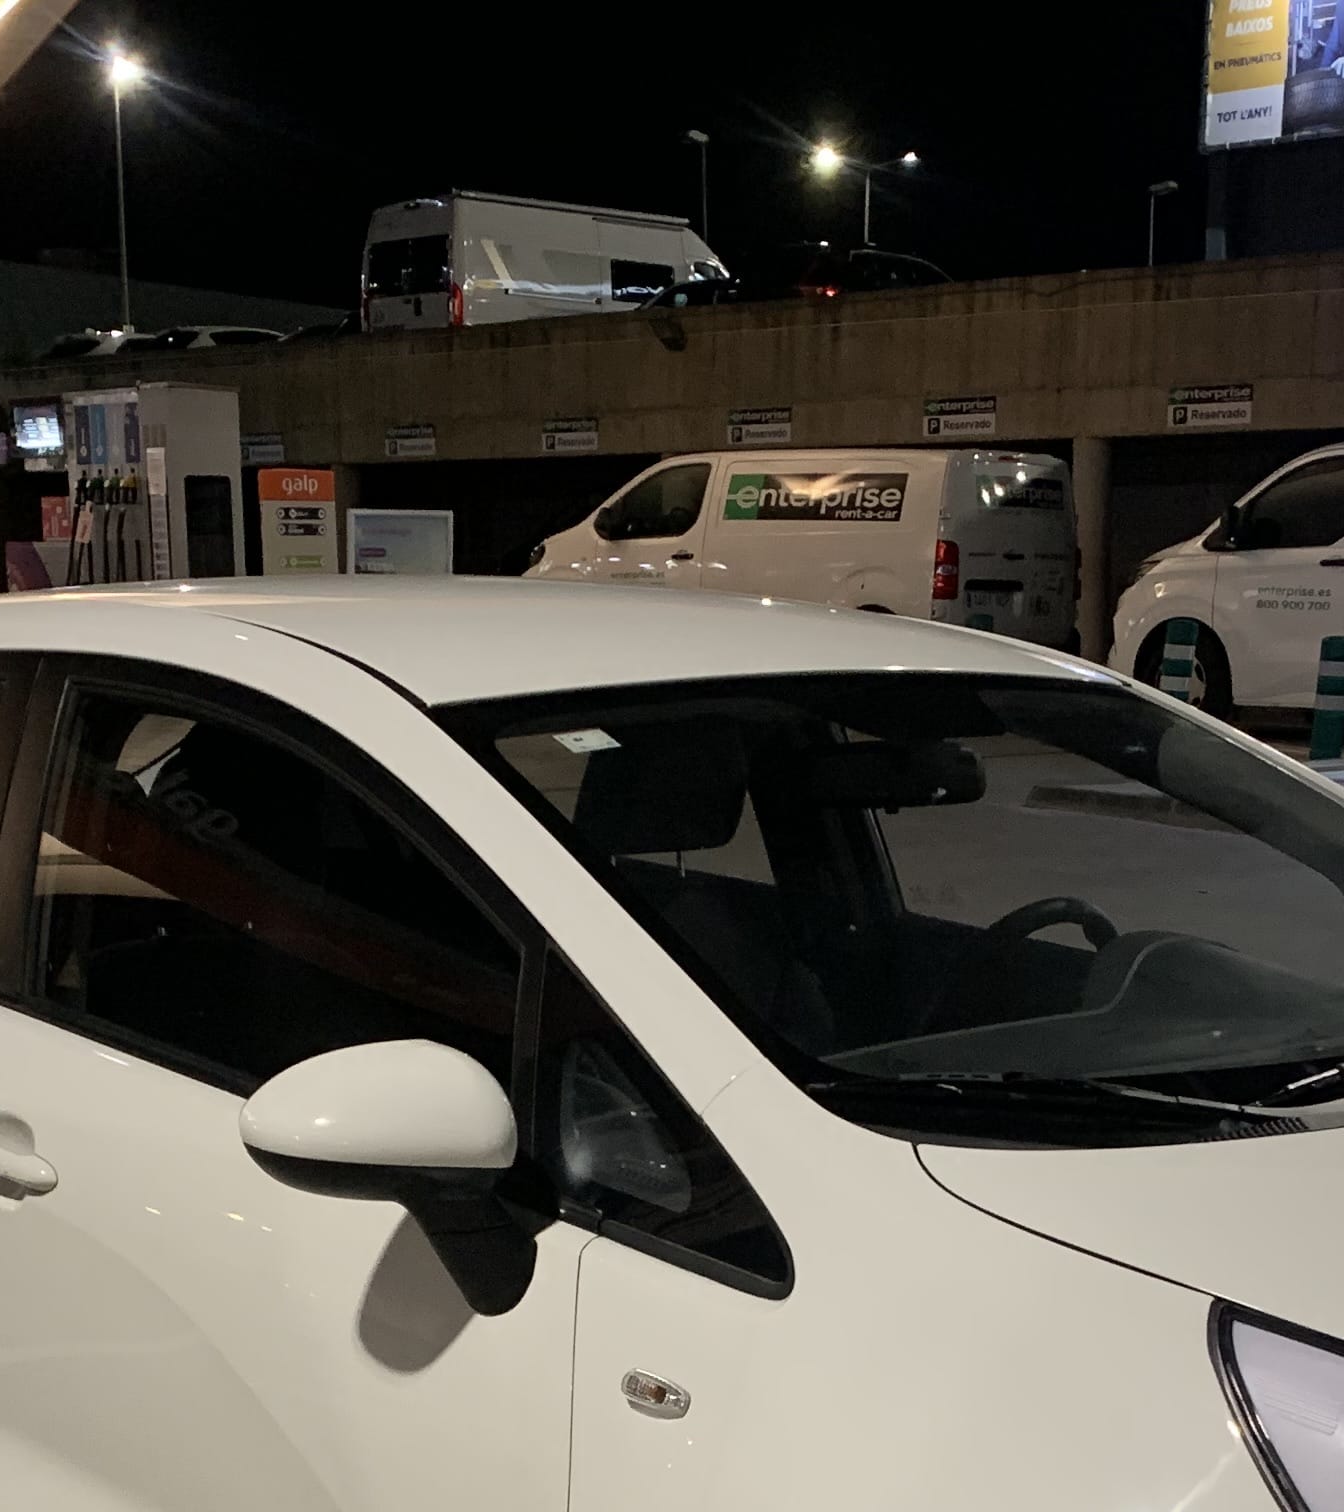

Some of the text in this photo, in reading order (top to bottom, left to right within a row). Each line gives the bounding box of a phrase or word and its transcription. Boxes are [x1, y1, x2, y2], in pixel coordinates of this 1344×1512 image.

[1225, 15, 1274, 37] BAIXOS
[1214, 60, 1226, 70] EN
[1217, 110, 1238, 123] TOT
[1172, 386, 1252, 401] enterprise
[926, 399, 994, 412] enterprise
[1191, 408, 1247, 420] Reservado
[943, 419, 992, 431] Reservado
[282, 474, 319, 495] galp
[727, 482, 902, 514] enterprise
[834, 508, 898, 520] rent-a-car
[1281, 599, 1305, 610] 900
[1307, 600, 1331, 611] 700
